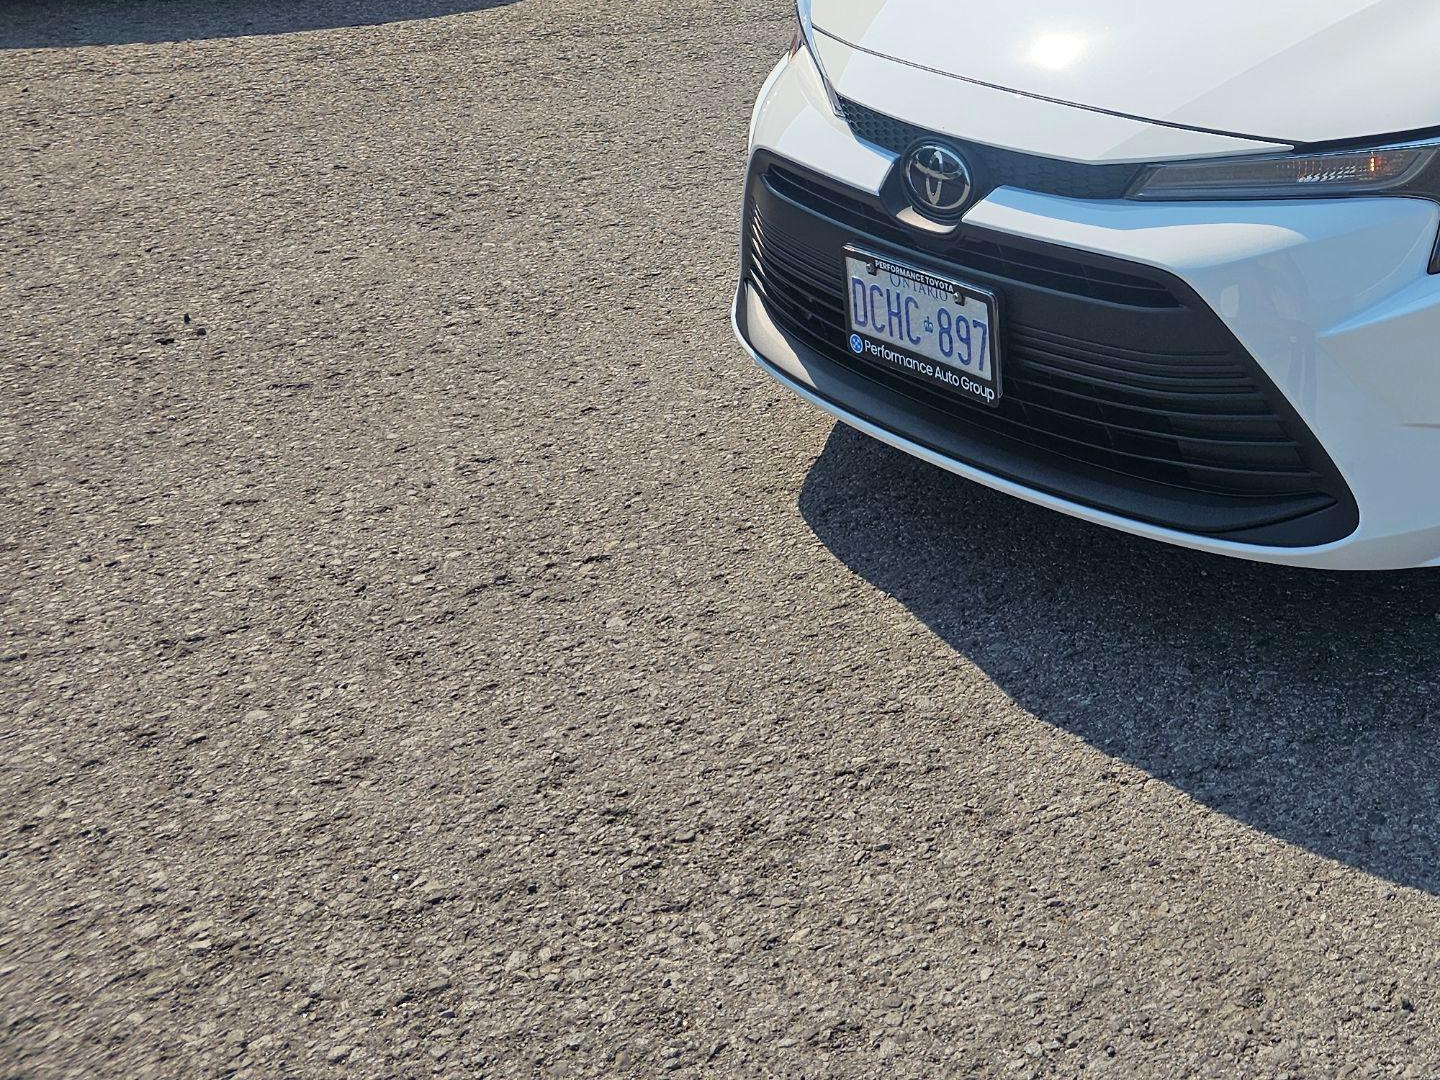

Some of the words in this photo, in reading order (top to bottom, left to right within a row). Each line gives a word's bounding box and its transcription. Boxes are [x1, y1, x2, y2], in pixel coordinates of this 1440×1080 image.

[875, 260, 924, 283] PERFORMANCE
[925, 275, 954, 292] TOYOTA
[851, 276, 921, 345] DCHC
[937, 307, 987, 371] 897
[864, 340, 933, 375] Performance
[935, 366, 959, 386] Auto
[960, 377, 995, 403] Group
